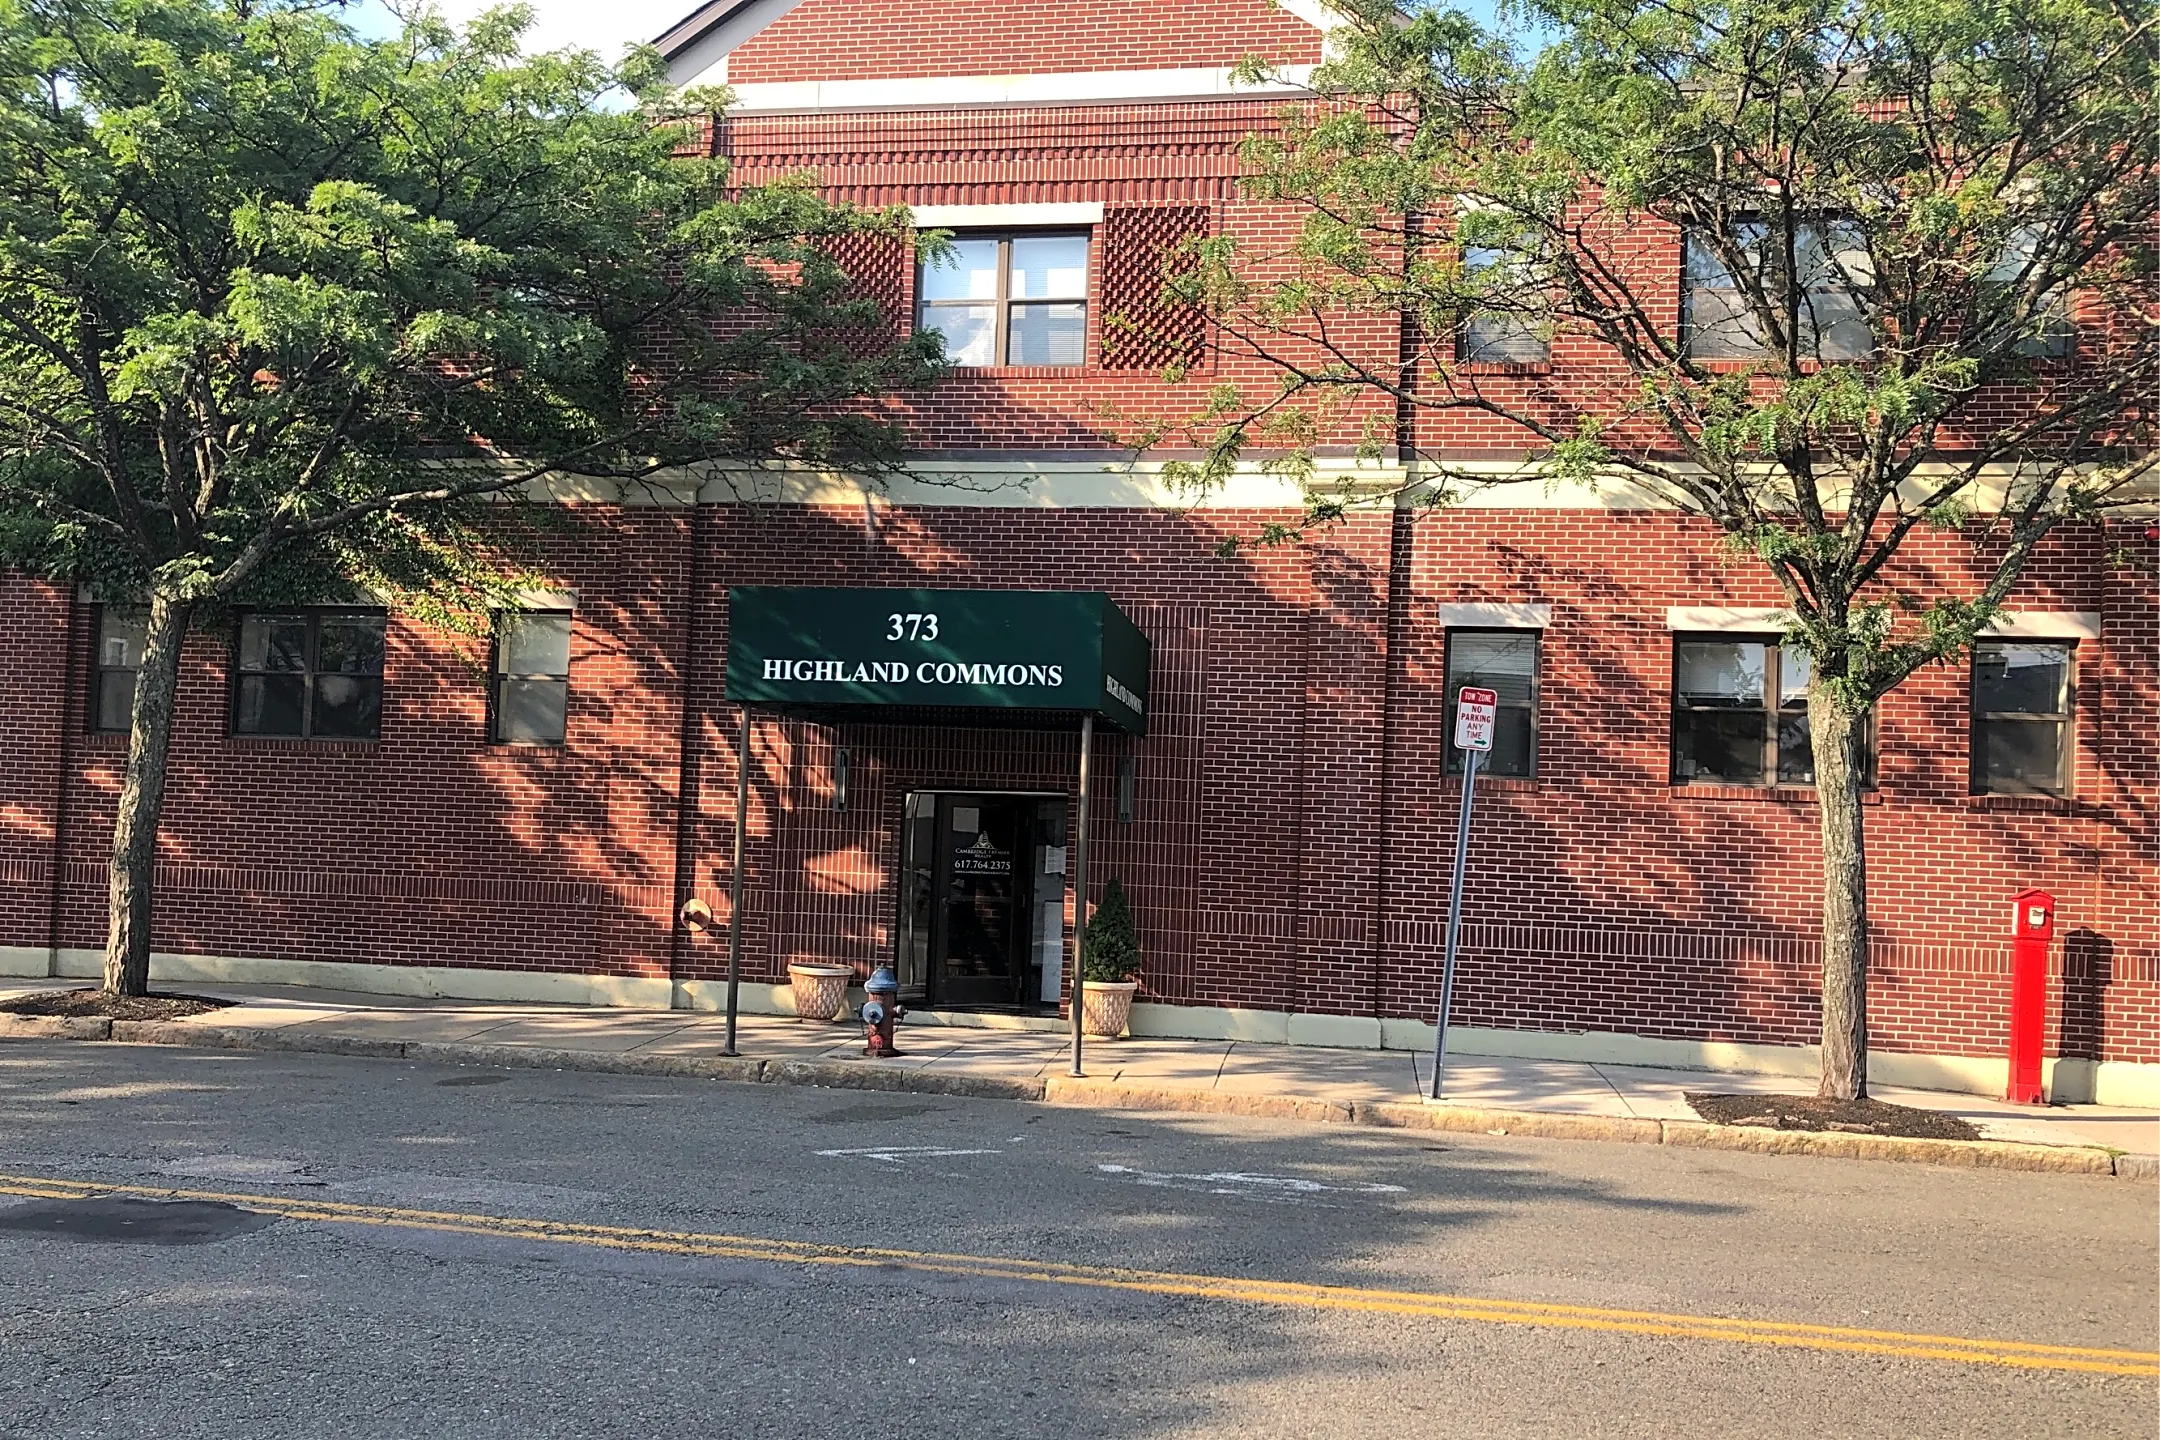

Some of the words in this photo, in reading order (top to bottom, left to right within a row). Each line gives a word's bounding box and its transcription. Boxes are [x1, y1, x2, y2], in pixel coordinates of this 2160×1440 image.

[886, 613, 939, 641] 373
[762, 659, 909, 683] HIGHLAND
[916, 663, 1063, 686] COMMONS
[1464, 691, 1476, 701] TOW
[1477, 692, 1492, 702] ZONE
[1471, 705, 1482, 713] NO
[1461, 713, 1491, 723] PARKING
[1466, 731, 1482, 739] TIME
[954, 860, 1011, 870] 617.764.2375
